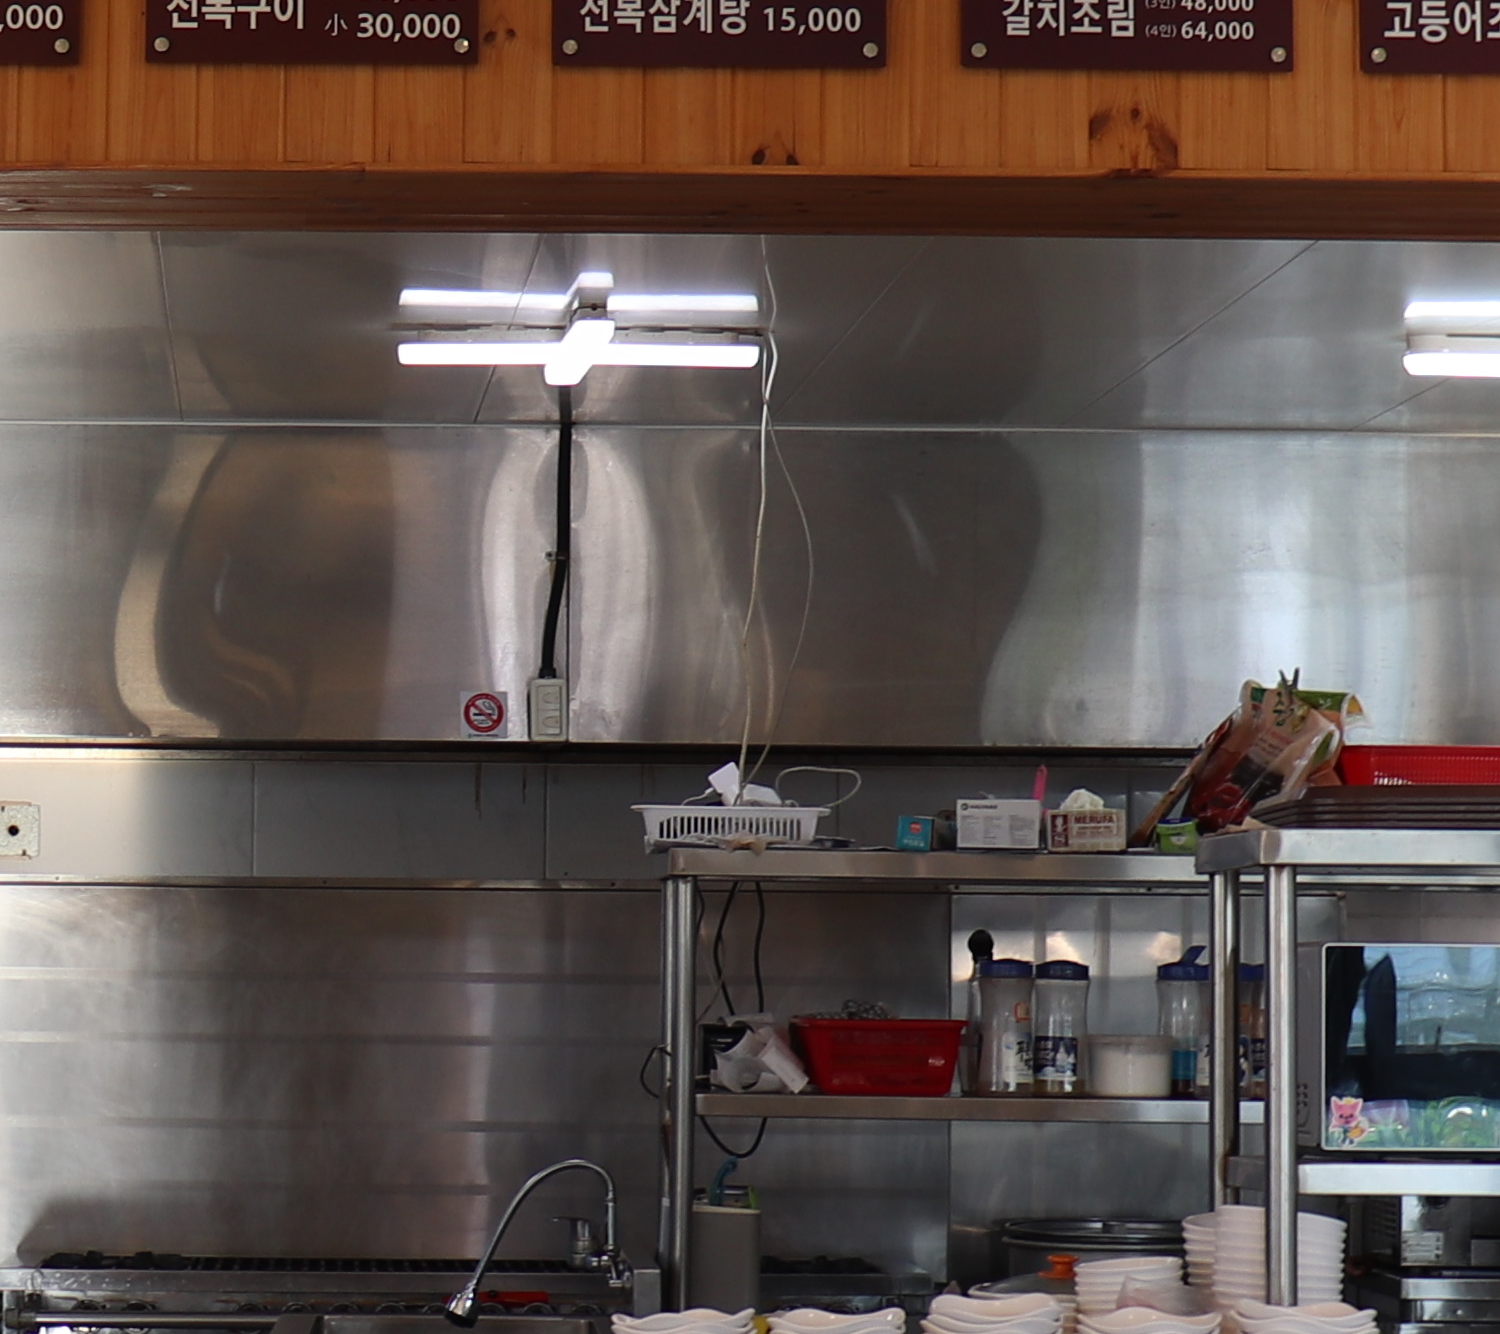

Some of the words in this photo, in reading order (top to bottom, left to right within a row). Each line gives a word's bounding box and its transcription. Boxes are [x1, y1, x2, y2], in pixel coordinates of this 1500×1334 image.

[324, 14, 349, 37] 小
[356, 12, 462, 43] 30,000
[762, 7, 862, 36] 15,000
[1144, 22, 1176, 39] (4인)
[1179, 20, 1255, 43] 64,000
